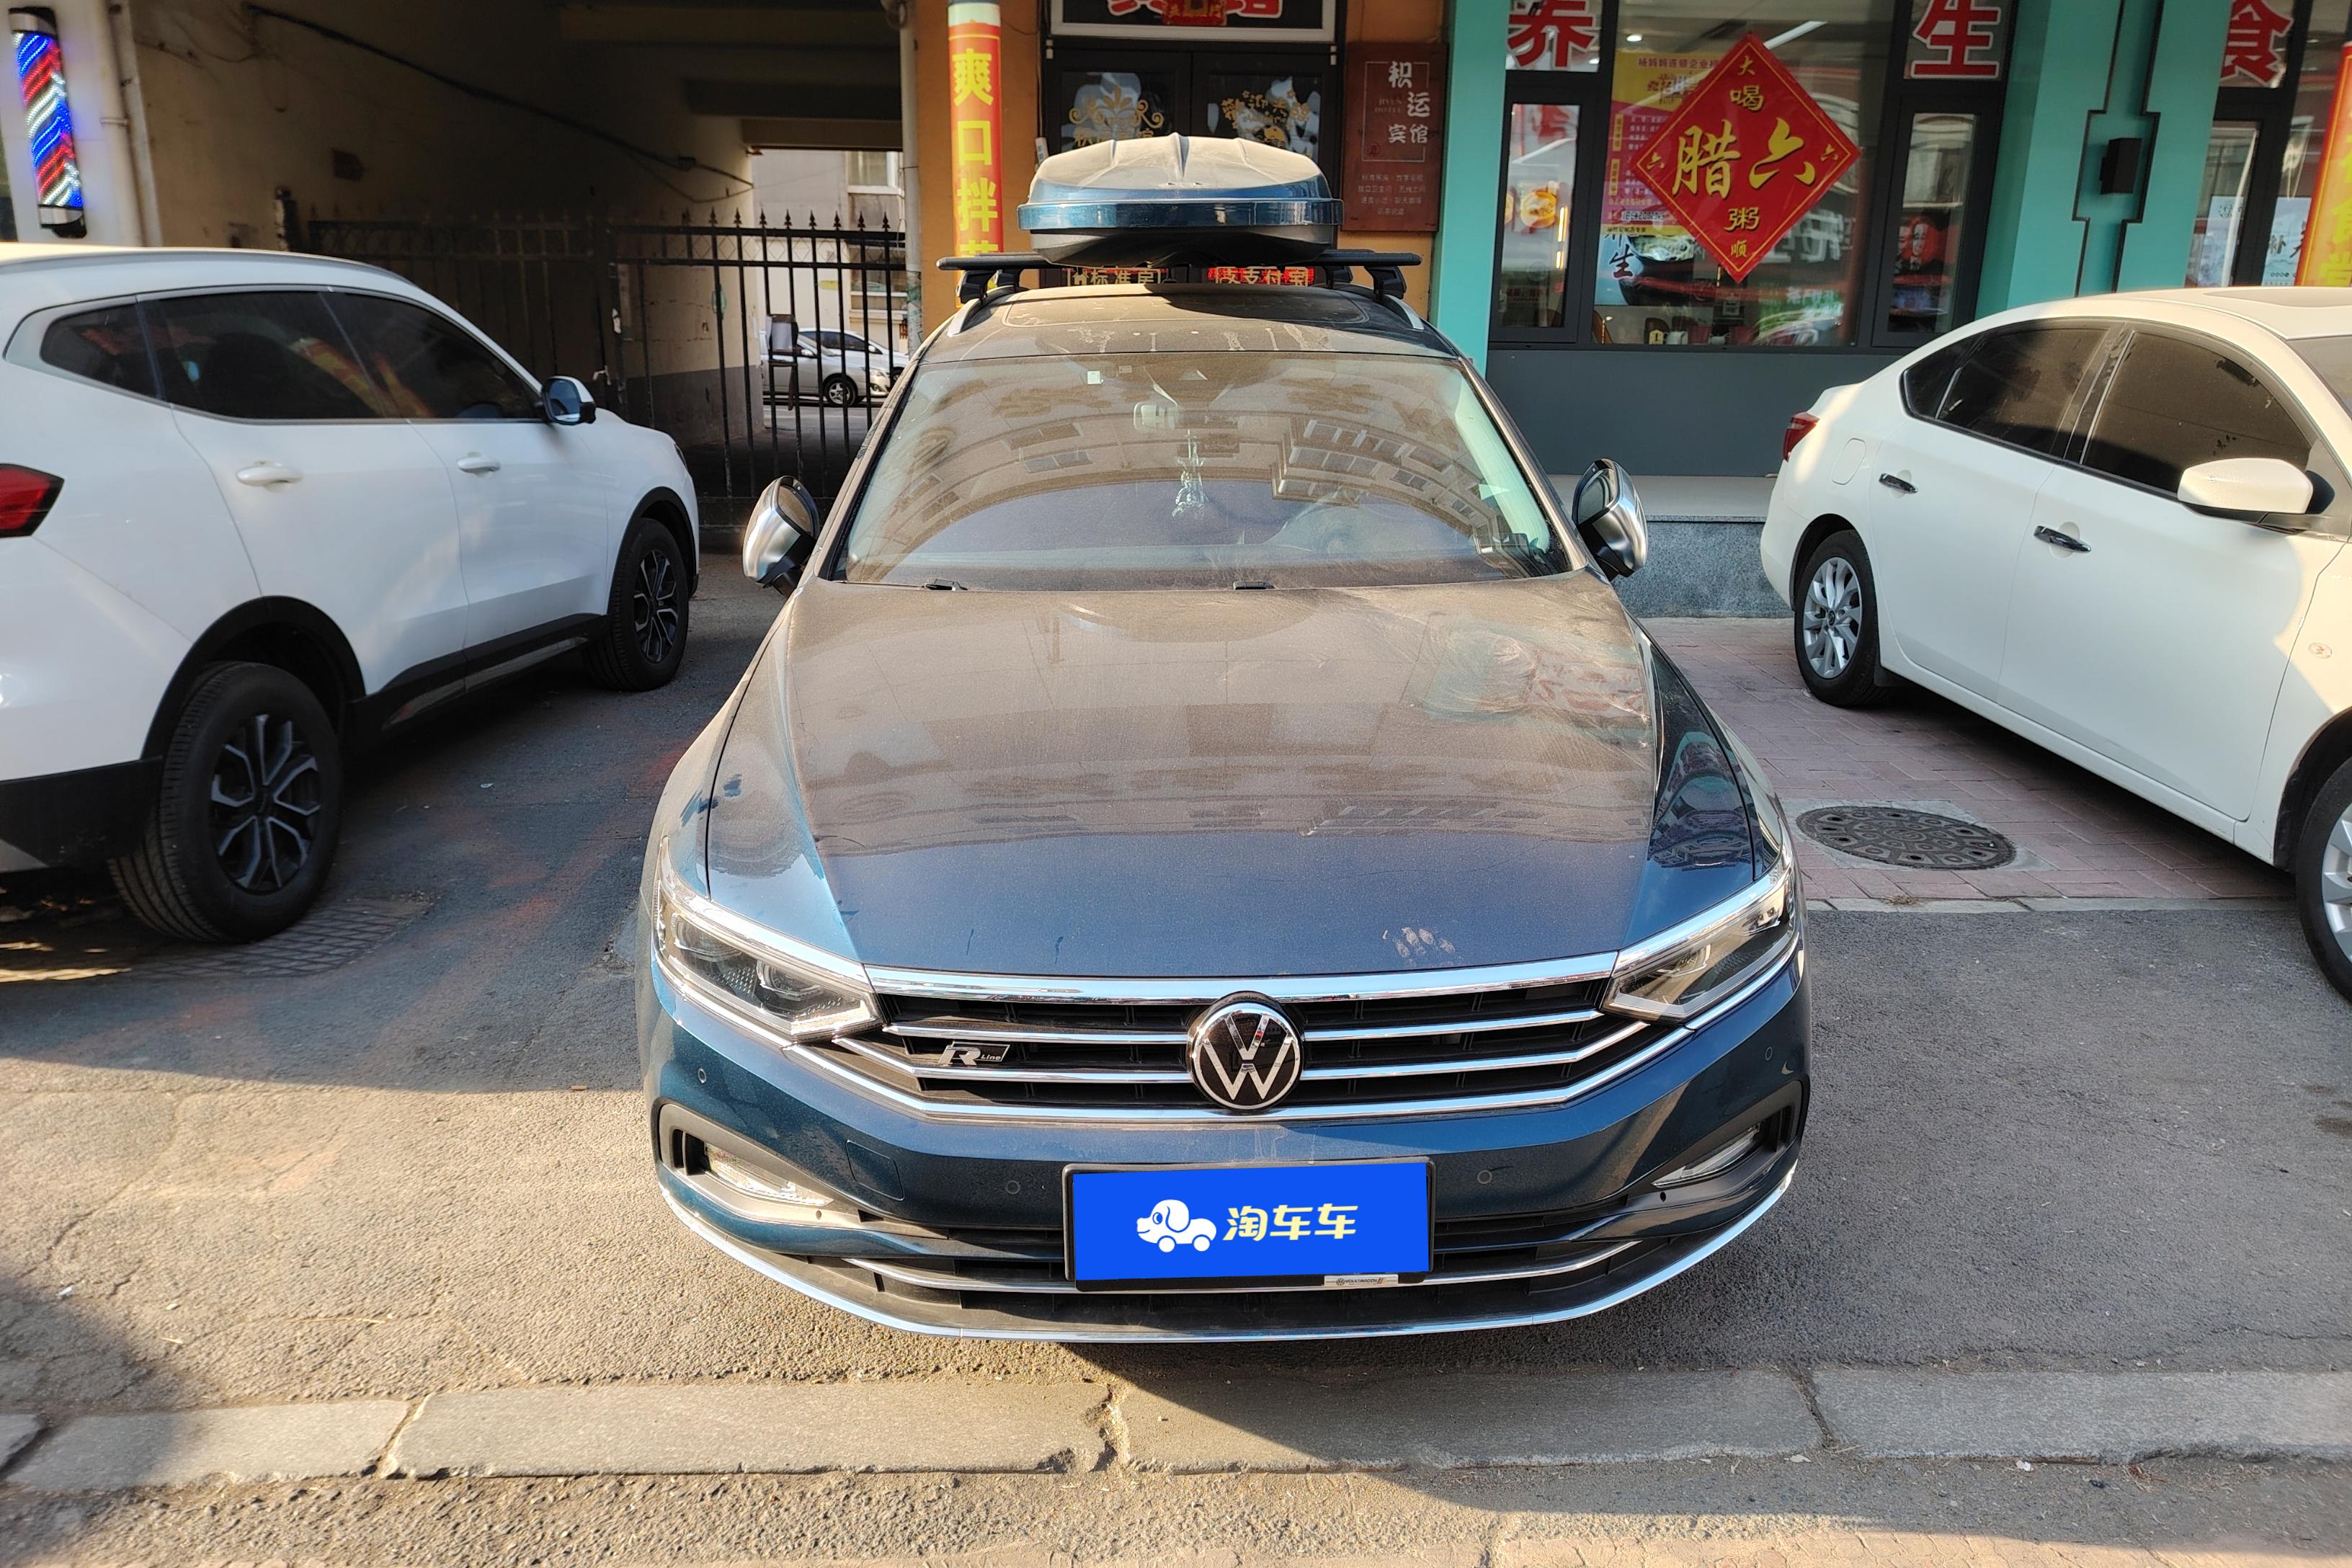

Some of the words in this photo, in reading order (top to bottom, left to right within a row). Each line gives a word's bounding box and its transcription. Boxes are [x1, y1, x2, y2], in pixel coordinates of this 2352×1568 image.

[1912, 0, 2000, 78] 生
[1737, 55, 1755, 76] 大
[1730, 85, 1764, 110] 喝
[1388, 124, 1429, 143] 宾馆
[952, 48, 999, 256] 爽口拌
[1647, 152, 1665, 169] 六
[1821, 144, 1838, 161] 六
[1724, 206, 1759, 231] 粥
[1731, 240, 1747, 258] 顺
[939, 1045, 981, 1066] R
